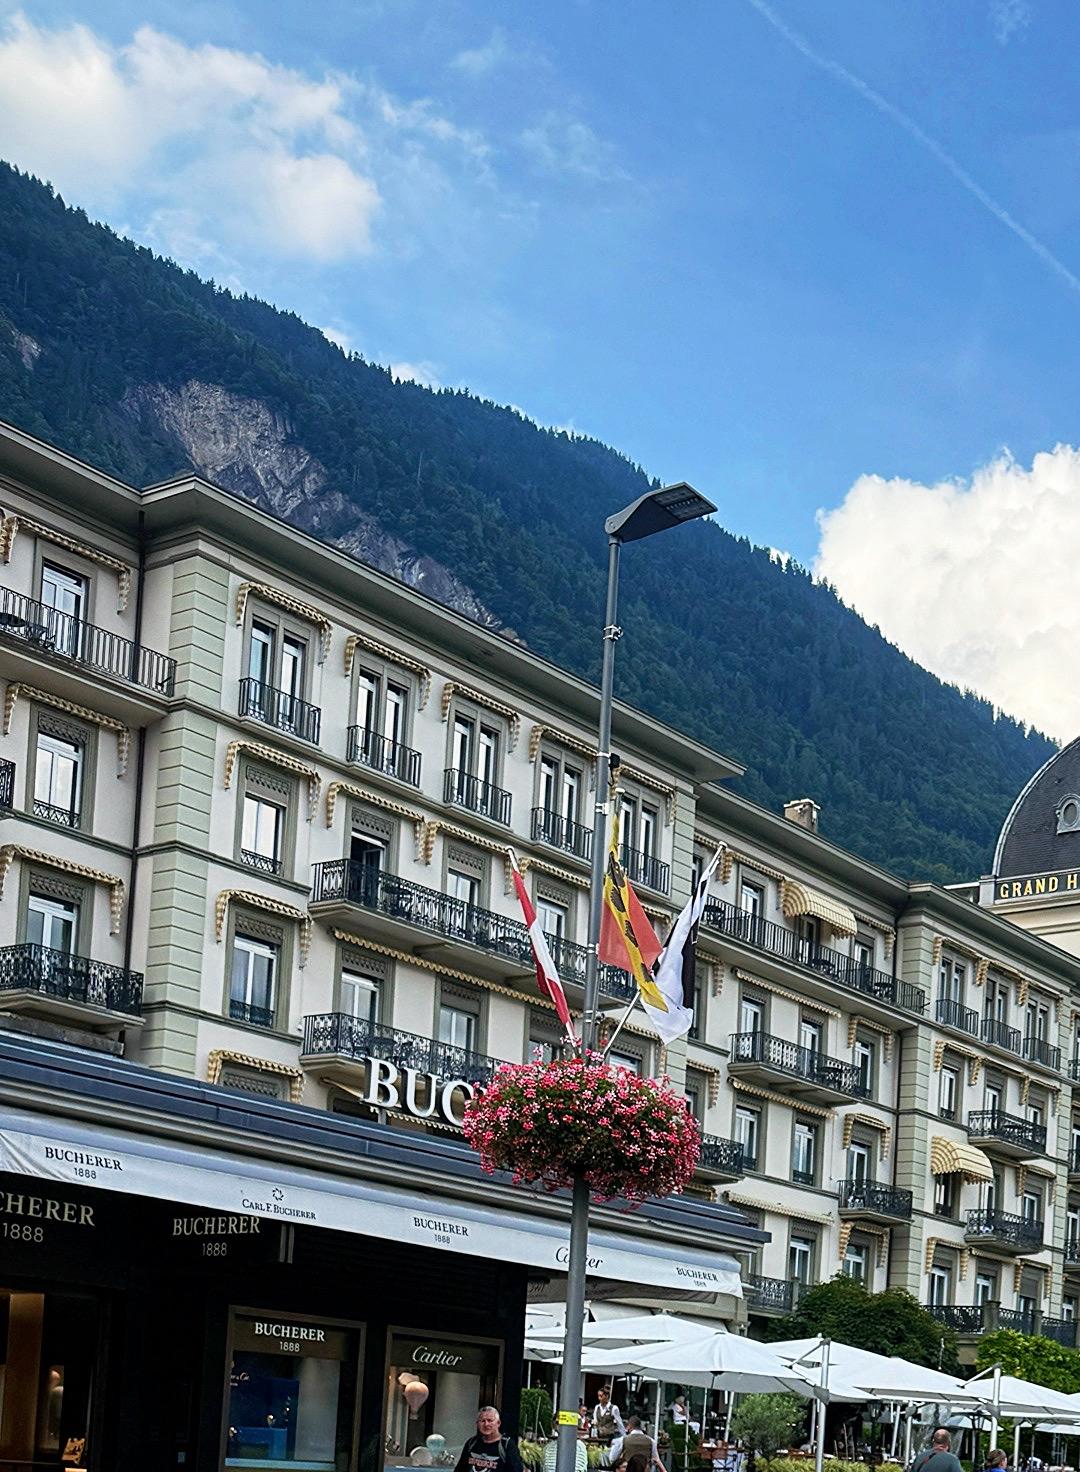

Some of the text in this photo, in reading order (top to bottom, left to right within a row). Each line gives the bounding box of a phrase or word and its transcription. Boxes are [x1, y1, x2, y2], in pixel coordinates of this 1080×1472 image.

[1000, 876, 1059, 899] GRAND
[363, 1056, 486, 1128] BUC
[45, 1146, 123, 1171] BUCHERER
[74, 1167, 97, 1180] 1888
[0, 1191, 96, 1227] HERER
[2, 1222, 44, 1242] 1888
[173, 1216, 261, 1236] BUCHERER
[413, 1216, 469, 1237] BUCHERER
[434, 1234, 451, 1244] 1888
[202, 1242, 228, 1257] 1888
[556, 1246, 603, 1269] Caier
[676, 1267, 719, 1282] BUCHERER
[255, 1322, 325, 1342] BUCHERER
[279, 1341, 300, 1353] 1888
[412, 1345, 463, 1367] Cartier
